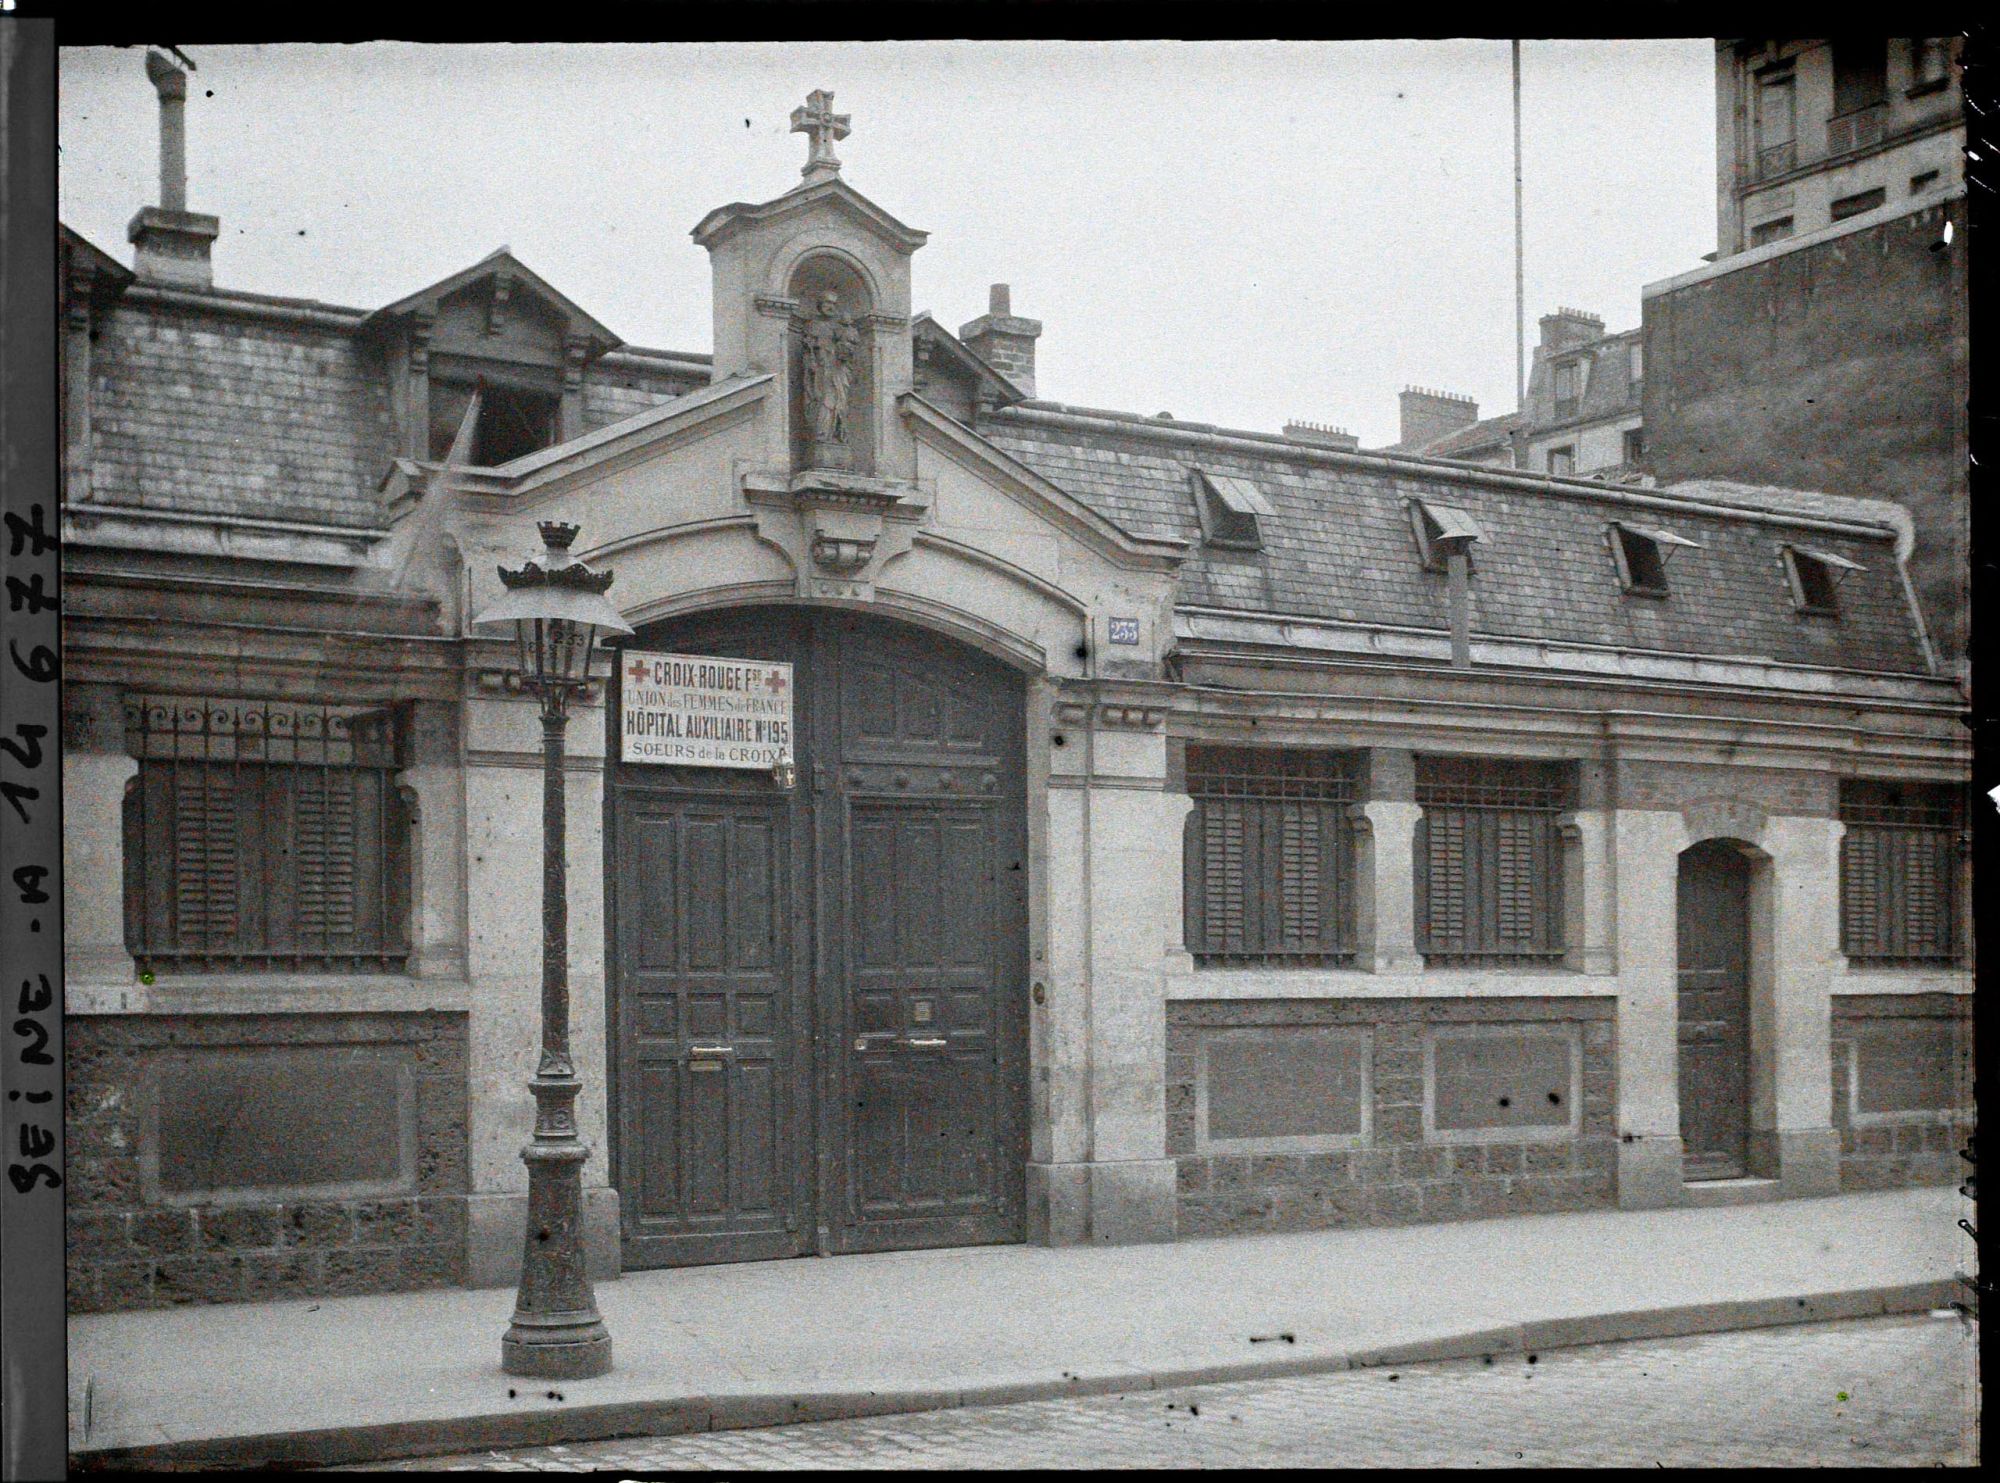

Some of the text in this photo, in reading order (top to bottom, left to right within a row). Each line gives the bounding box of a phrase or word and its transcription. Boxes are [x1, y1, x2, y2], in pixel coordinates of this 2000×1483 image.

[654, 661, 741, 691] CROIX-ROUGE
[624, 689, 666, 706] UNION
[684, 693, 734, 711] FEMMES
[746, 698, 786, 715] FRANCE
[627, 707, 682, 737] HÔPITAL
[686, 714, 752, 742] AUXILIAIRE
[768, 720, 788, 744] 195
[632, 742, 777, 763] SOEURS de la CROIX
[13, 864, 49, 904] A
